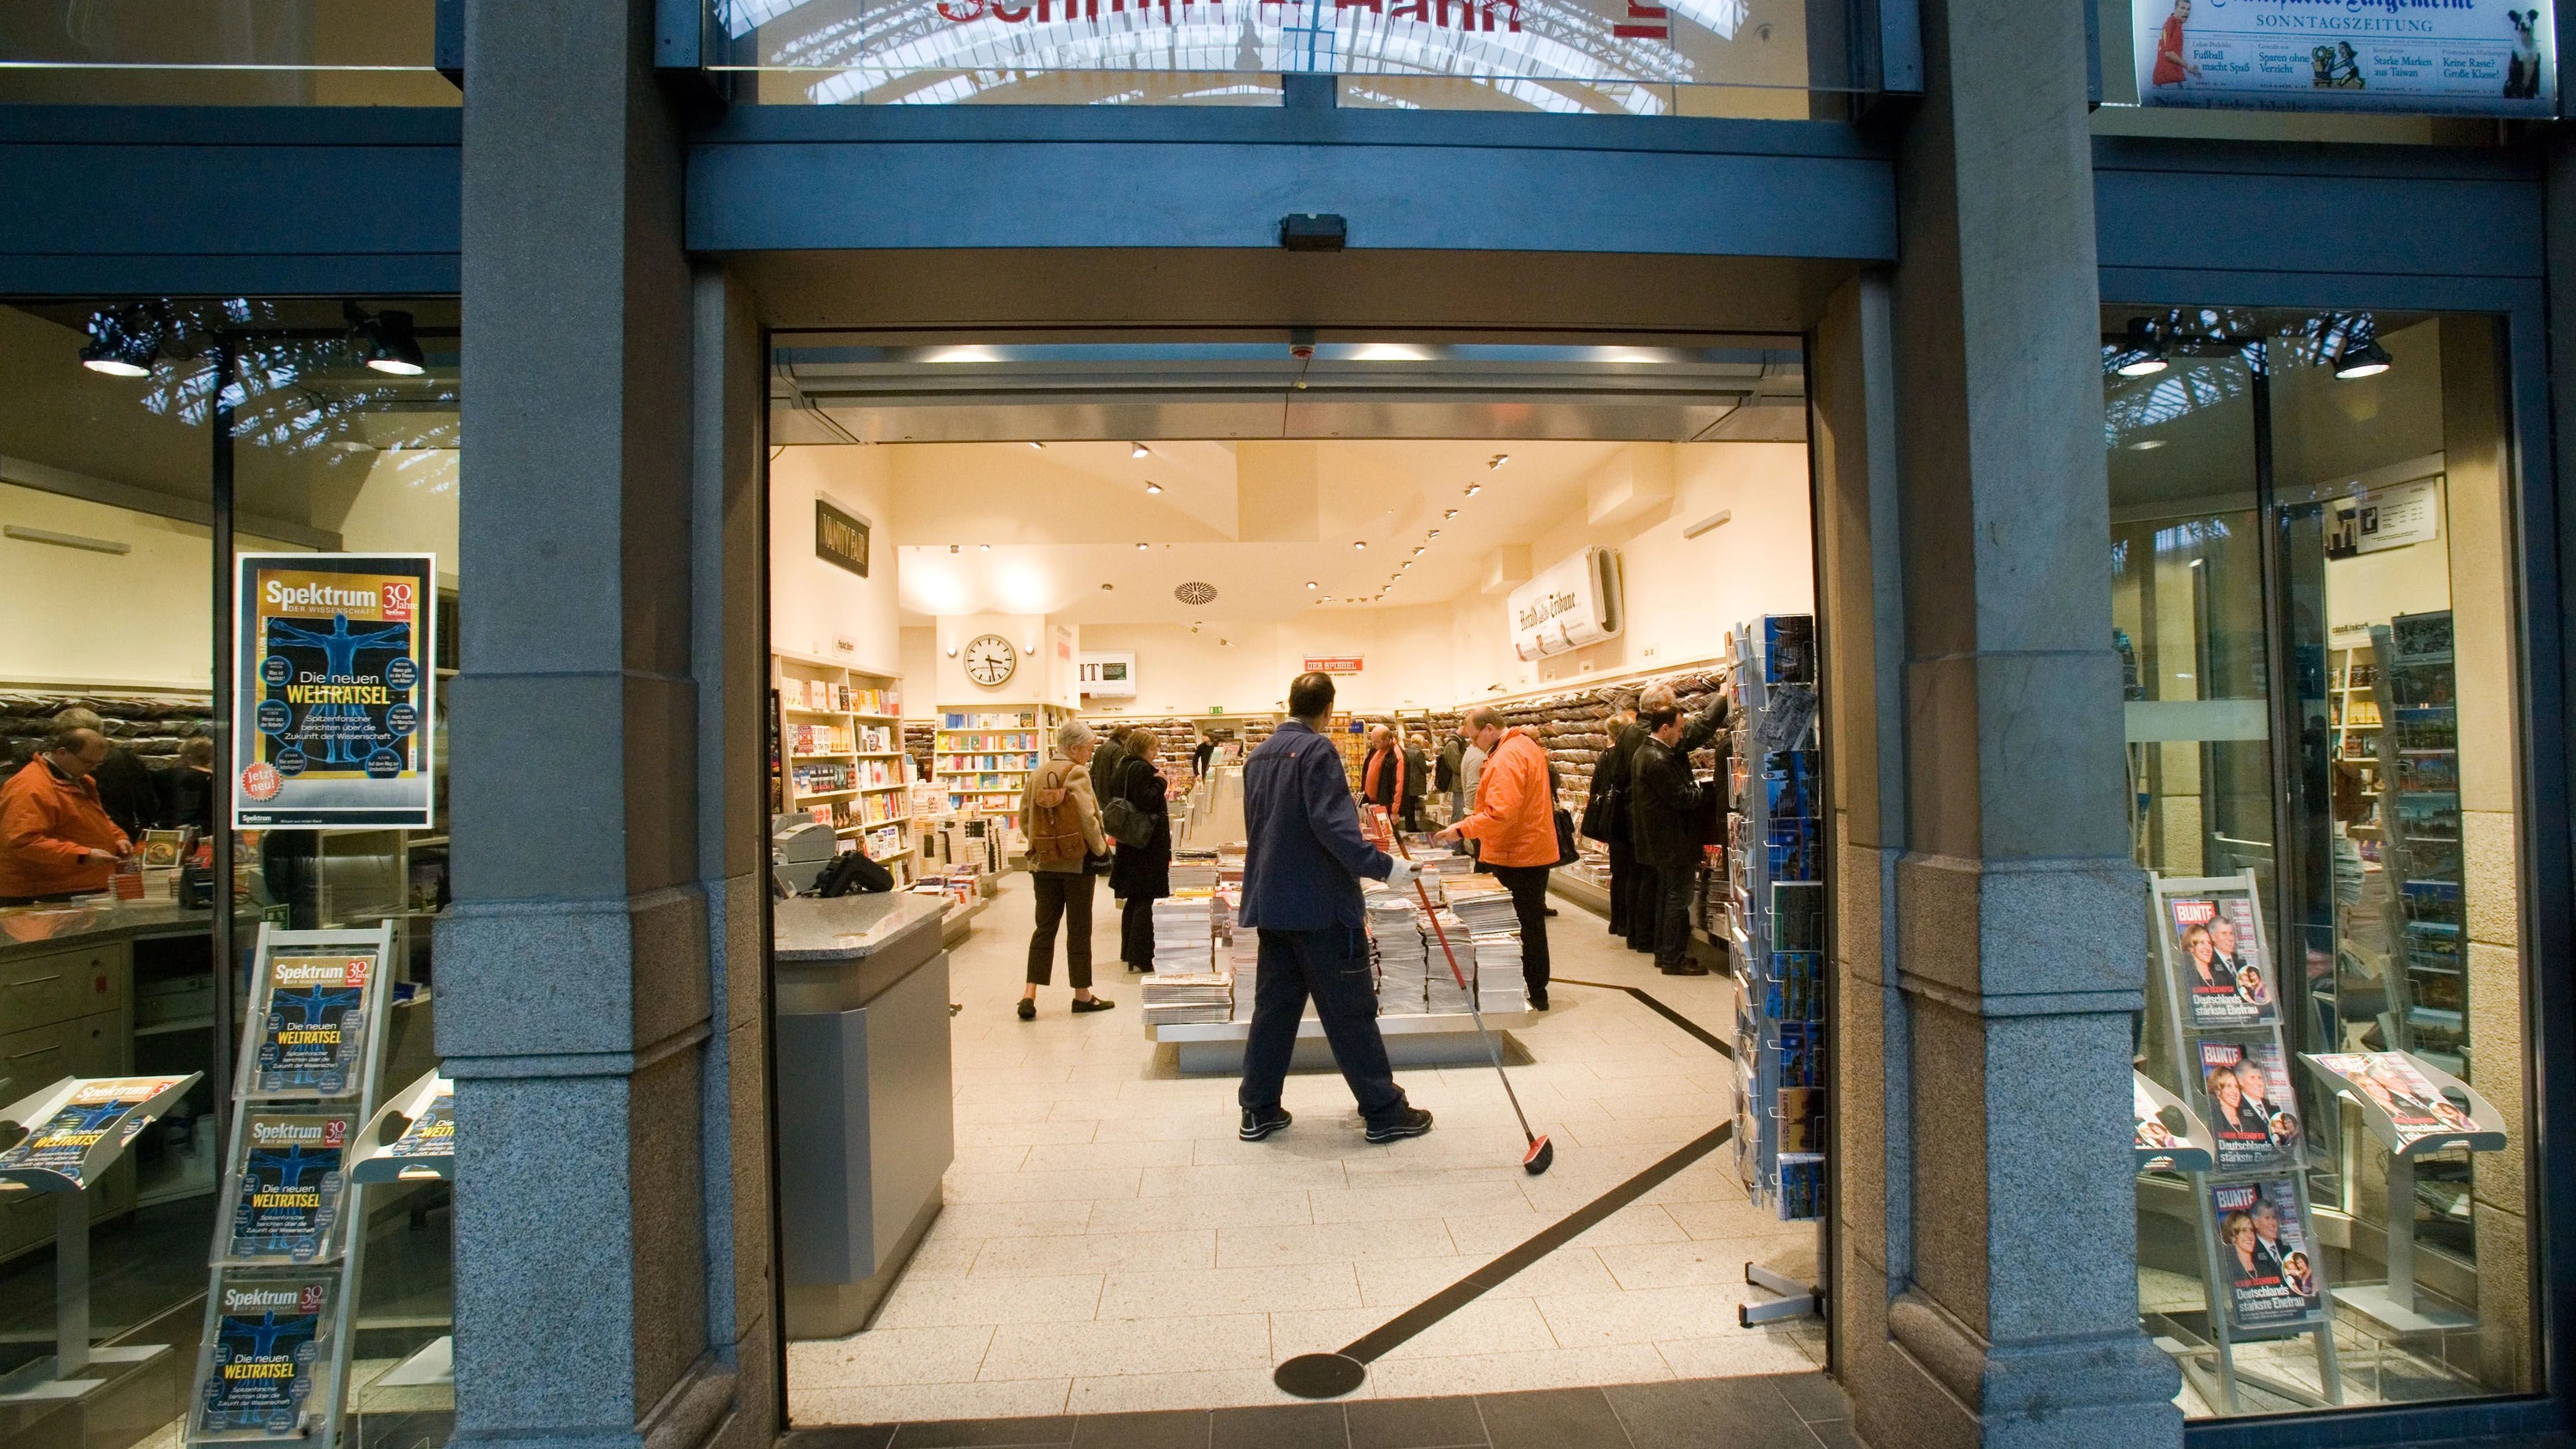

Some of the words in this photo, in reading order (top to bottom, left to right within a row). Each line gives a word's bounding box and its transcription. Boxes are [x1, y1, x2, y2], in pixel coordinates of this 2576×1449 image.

[2256, 14, 2433, 33] SONNTAGSZEITUNG
[2193, 49, 2224, 59] Fußball
[2259, 52, 2287, 65] Sparen
[2289, 54, 2310, 63] ohne
[2373, 55, 2399, 65] Starke
[2402, 57, 2433, 66] Marken
[2202, 62, 2227, 71] macht
[2230, 62, 2250, 73] Spaß
[2260, 63, 2293, 73] Verzicht
[2443, 58, 2467, 68] Keine
[2470, 59, 2495, 68] Rasse?
[2390, 67, 2418, 77] Taiwan
[2443, 69, 2470, 78] Große
[2472, 69, 2500, 79] Klasse!
[823, 514, 850, 557] VANITY
[850, 527, 866, 565] FAIR
[266, 580, 376, 612] Spektrum
[383, 584, 411, 608] 30
[289, 605, 306, 613] DER
[309, 606, 375, 615] WISSENSCHAFT
[396, 599, 418, 611] Jahre
[1520, 605, 1539, 631] Herald
[1549, 591, 1576, 618] Tribune
[301, 671, 326, 684] Die
[331, 674, 380, 685] neuen
[287, 685, 391, 704] WELTRÄTSEL
[306, 715, 372, 723] Spitzenforscher
[342, 723, 361, 732] über
[284, 732, 319, 740] Zukunft
[250, 778, 275, 793] neu!
[242, 814, 272, 824] Spektrum
[276, 964, 343, 984] Spektrum
[347, 961, 368, 978] 30
[2192, 993, 2242, 1005] Deutschlands
[2196, 1006, 2226, 1016] stärkste
[2226, 1004, 2259, 1015] Ehefrau
[288, 1022, 303, 1031] Die
[306, 1022, 337, 1031] neuen
[277, 1031, 342, 1044] WELTRÄTSEL
[76, 1086, 153, 1103] Spektrum
[252, 1122, 322, 1144] Spektrum
[325, 1120, 347, 1139] 30
[2218, 1139, 2273, 1150] Deutschlands
[2220, 1151, 2253, 1163] stärkste
[262, 1184, 279, 1193] Die
[252, 1193, 320, 1208] WELTRÄTSEL
[301, 1284, 323, 1305] 30
[2236, 1285, 2290, 1300] Deutschlands
[225, 1288, 297, 1311] Spektrum
[2239, 1299, 2273, 1312] stärkste
[2273, 1297, 2306, 1311] Ehefrau
[234, 1354, 252, 1363] Die
[254, 1355, 289, 1363] neuen
[224, 1363, 295, 1379] WELTRÄTSEL
